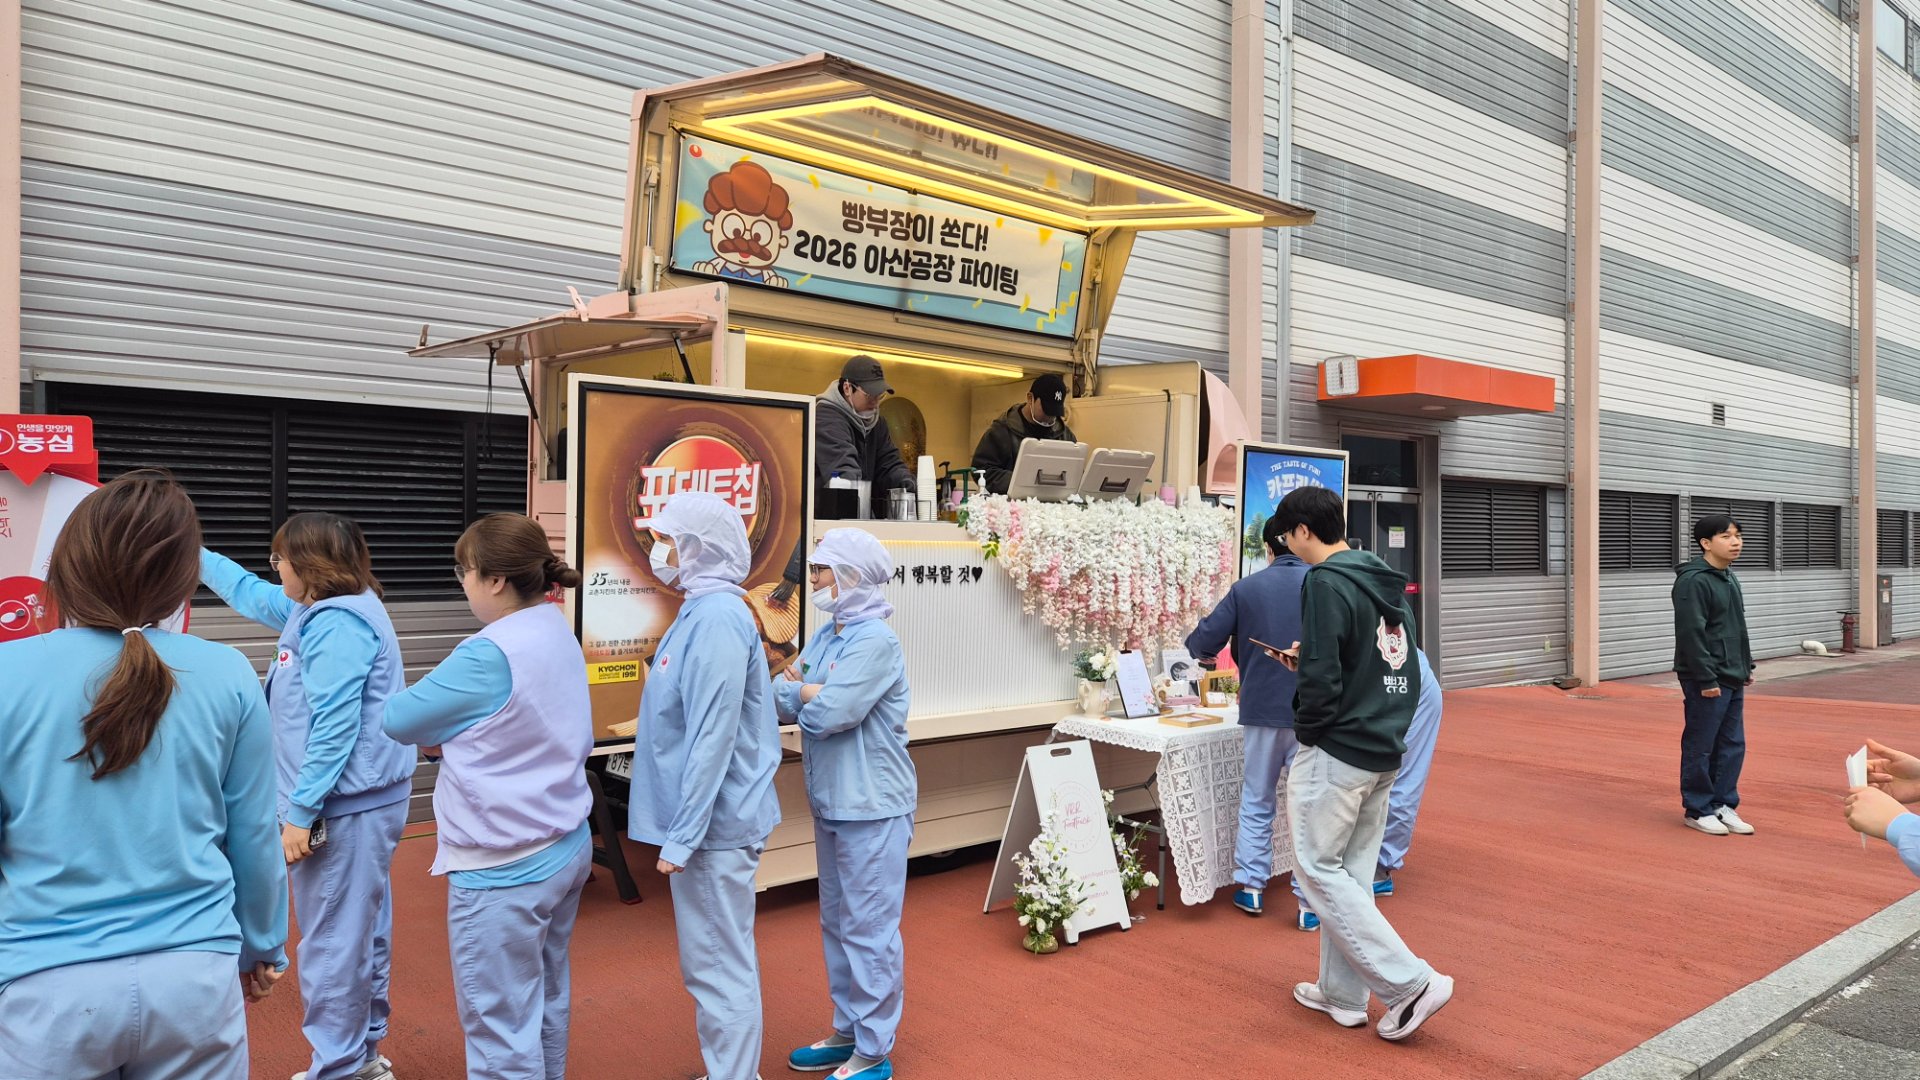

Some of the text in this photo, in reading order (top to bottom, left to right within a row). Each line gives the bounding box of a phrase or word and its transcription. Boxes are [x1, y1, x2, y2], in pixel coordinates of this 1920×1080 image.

[842, 200, 988, 251] 빵부장이 쏜다!
[793, 229, 1018, 295] 2026 아산공장 파이팅
[17, 424, 73, 433] 인생을 맛있게
[17, 433, 73, 453] 농심
[1270, 462, 1282, 472] THE
[1283, 460, 1300, 468] TASTE
[912, 565, 953, 584] 행복할
[958, 565, 970, 584] 것
[598, 664, 637, 673] KYOCHON
